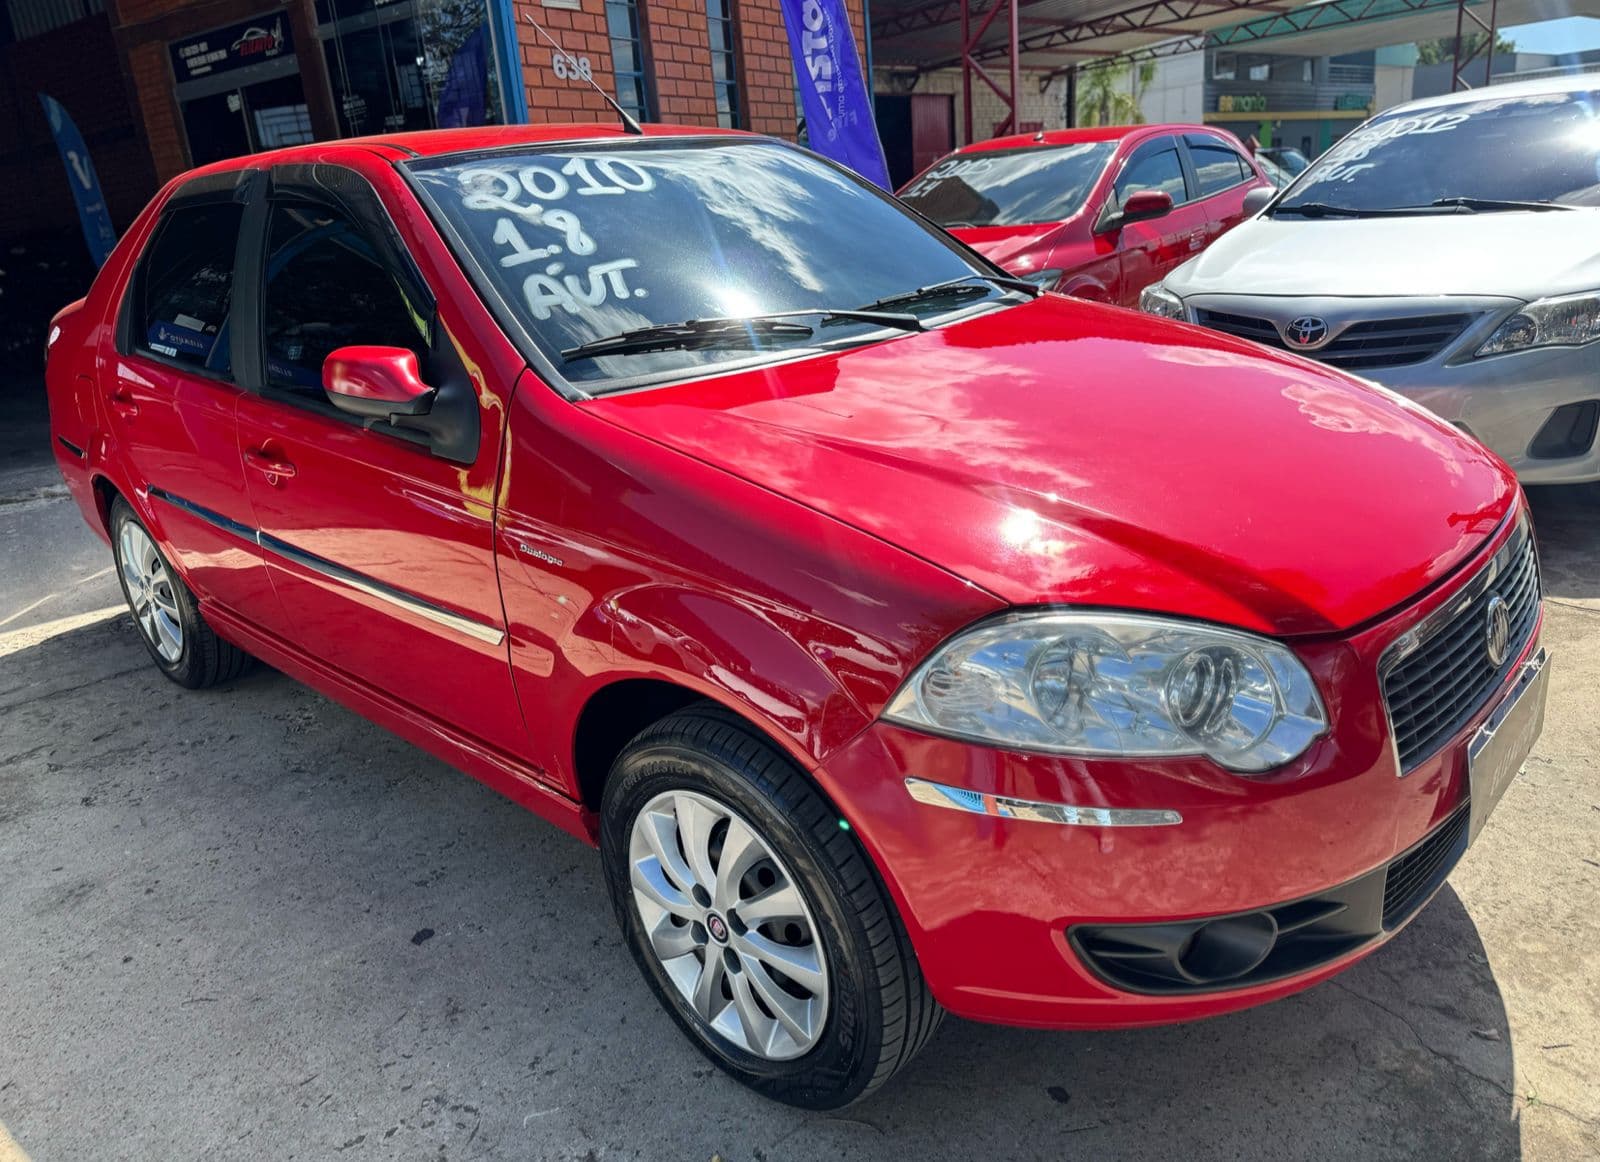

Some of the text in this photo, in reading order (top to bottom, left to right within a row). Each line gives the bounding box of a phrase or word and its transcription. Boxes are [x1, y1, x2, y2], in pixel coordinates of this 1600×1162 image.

[553, 54, 592, 82] 638
[458, 157, 657, 217] 2010
[493, 208, 598, 268] 1.8
